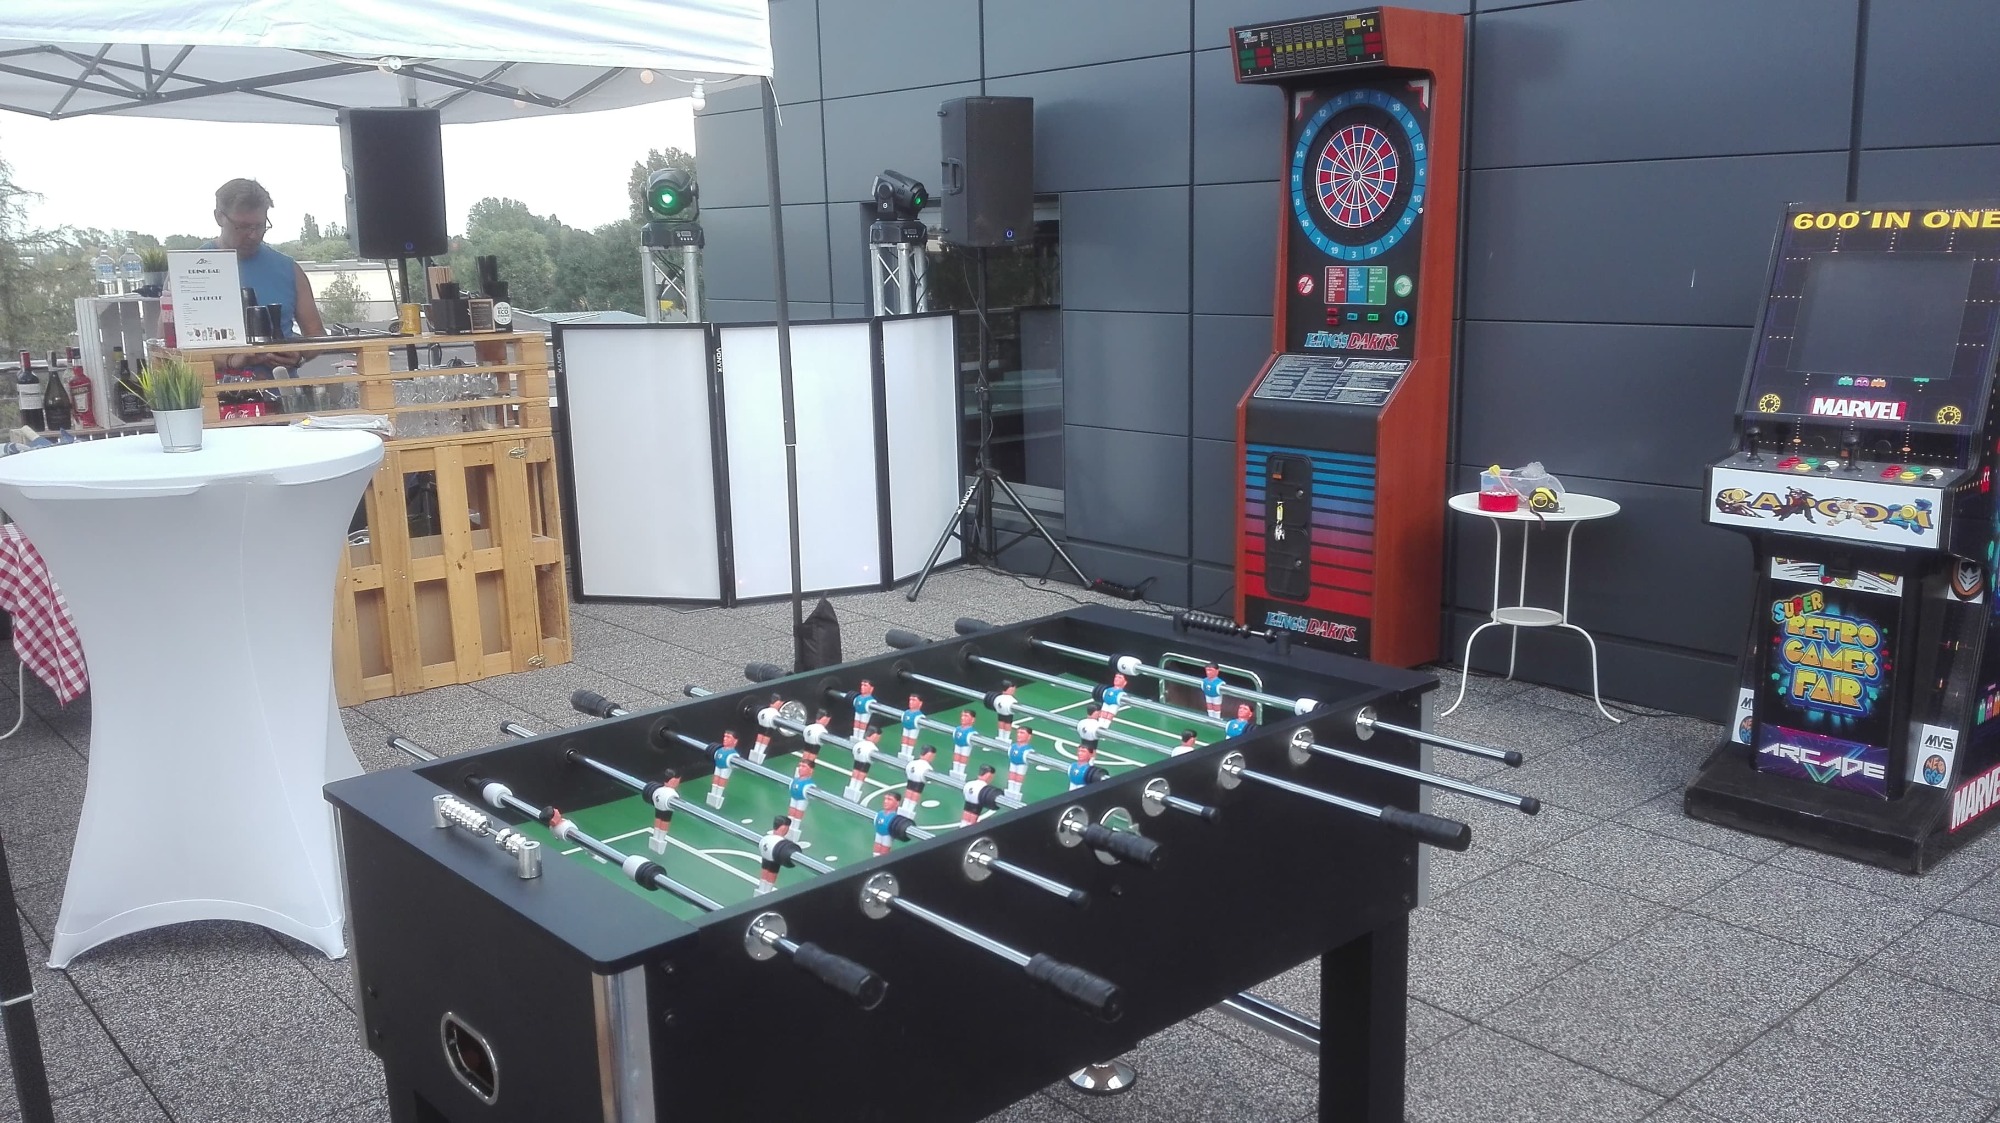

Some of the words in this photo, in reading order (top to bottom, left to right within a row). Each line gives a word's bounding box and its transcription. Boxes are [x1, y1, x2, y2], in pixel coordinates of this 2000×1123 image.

[1355, 91, 1364, 99] 20
[1392, 103, 1400, 111] 18
[1293, 174, 1299, 182] 11
[1413, 195, 1422, 203] 10
[1301, 219, 1309, 227] 16
[1403, 217, 1411, 225] 15
[1793, 212, 1860, 230] 600
[1871, 211, 1911, 229] IN
[1923, 211, 2000, 229] ONE
[1346, 332, 1400, 351] DARTS
[715, 347, 723, 373] VONYX
[1812, 397, 1902, 420] MARVEL
[956, 485, 976, 514] VONYX
[1773, 590, 1824, 622] SUPER
[1306, 617, 1358, 642] DARTS
[1786, 614, 1879, 648] RETRO
[1785, 639, 1878, 678] GAMES
[1793, 669, 1863, 709] FAIR
[1924, 734, 1954, 750] MVS
[1759, 742, 1885, 780] ARCADE
